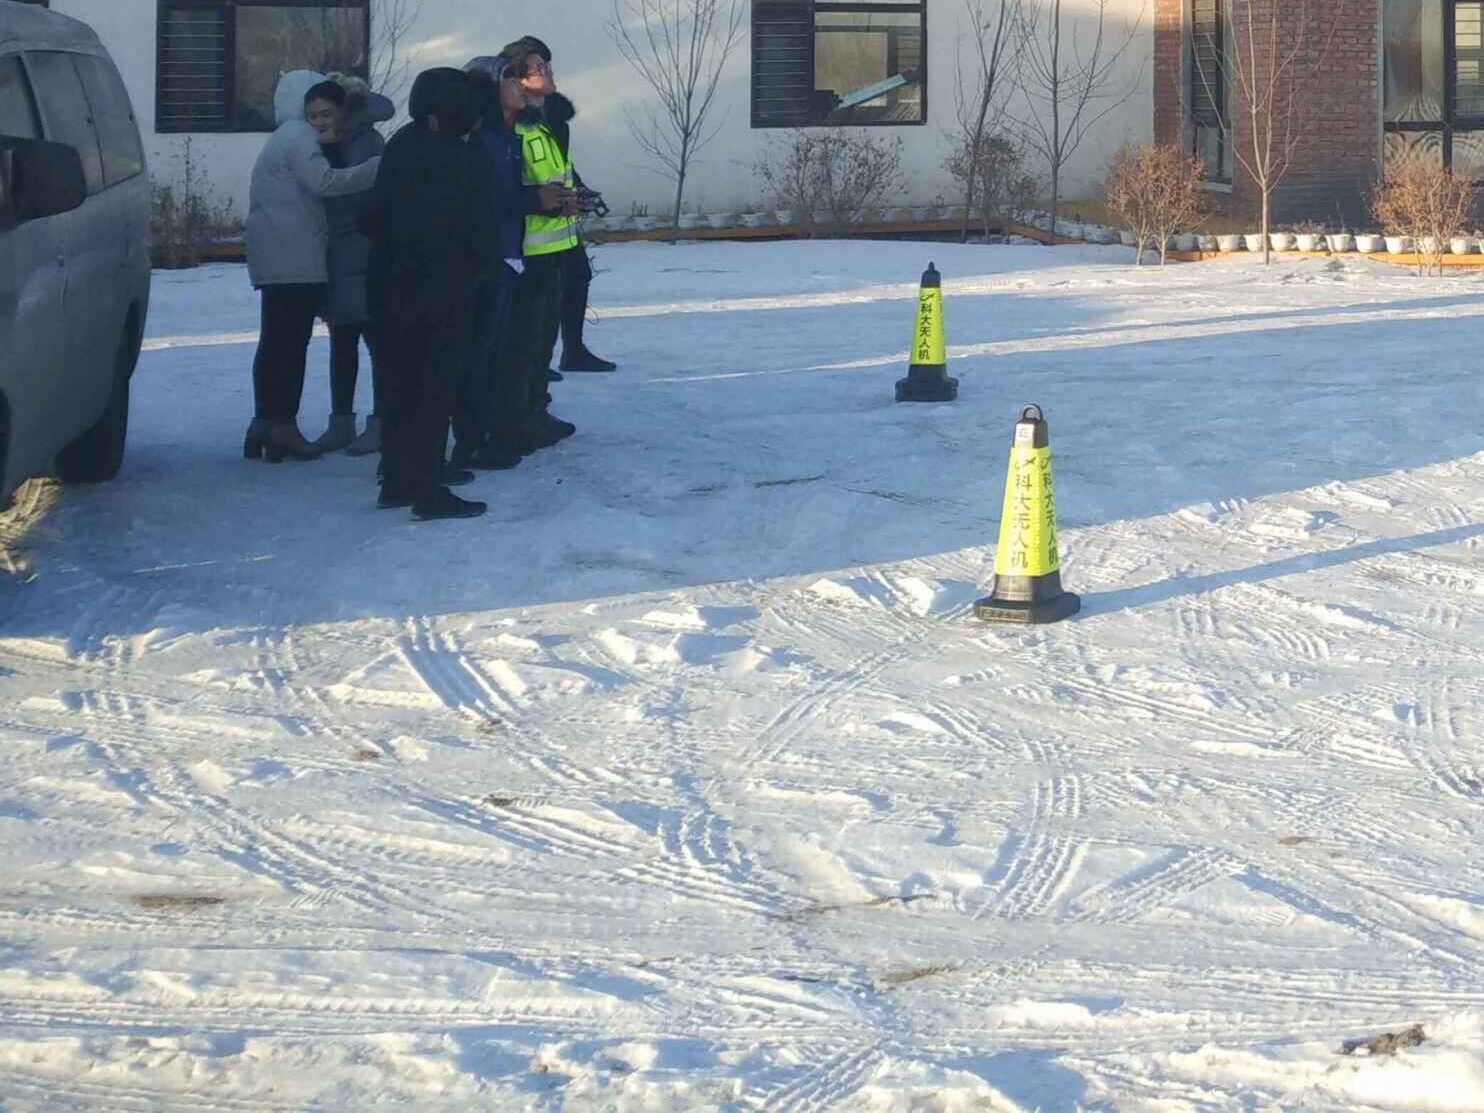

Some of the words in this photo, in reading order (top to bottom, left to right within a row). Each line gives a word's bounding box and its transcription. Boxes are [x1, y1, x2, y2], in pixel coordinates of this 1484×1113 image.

[919, 303, 932, 360] 科大无人机
[1011, 474, 1033, 568] 科大无人机
